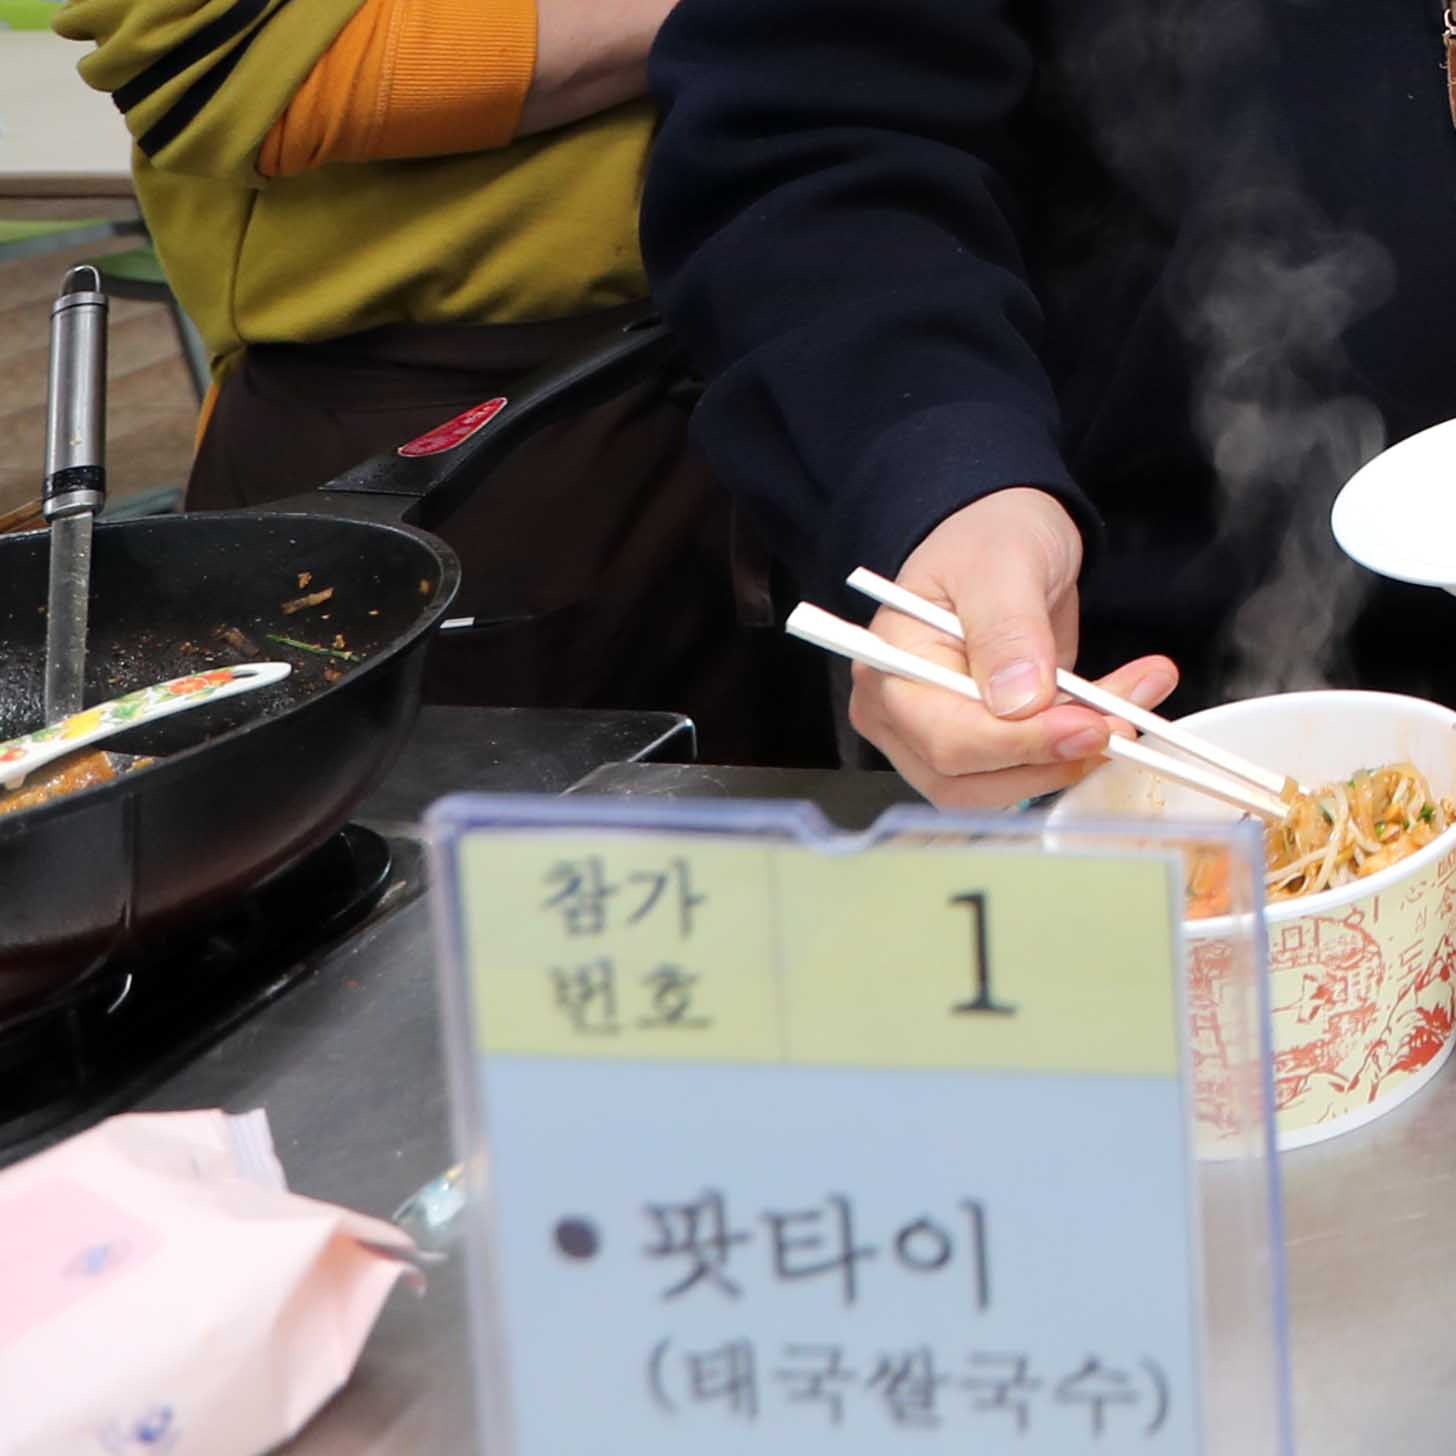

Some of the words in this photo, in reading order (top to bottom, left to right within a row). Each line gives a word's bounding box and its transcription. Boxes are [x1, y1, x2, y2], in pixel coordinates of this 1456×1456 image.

[543, 855, 707, 940] 참가
[548, 957, 714, 1037] 번호
[947, 888, 1018, 1017] 1
[641, 1187, 990, 1312] 팟타이
[645, 1337, 1173, 1440] (태국쌀국수)
